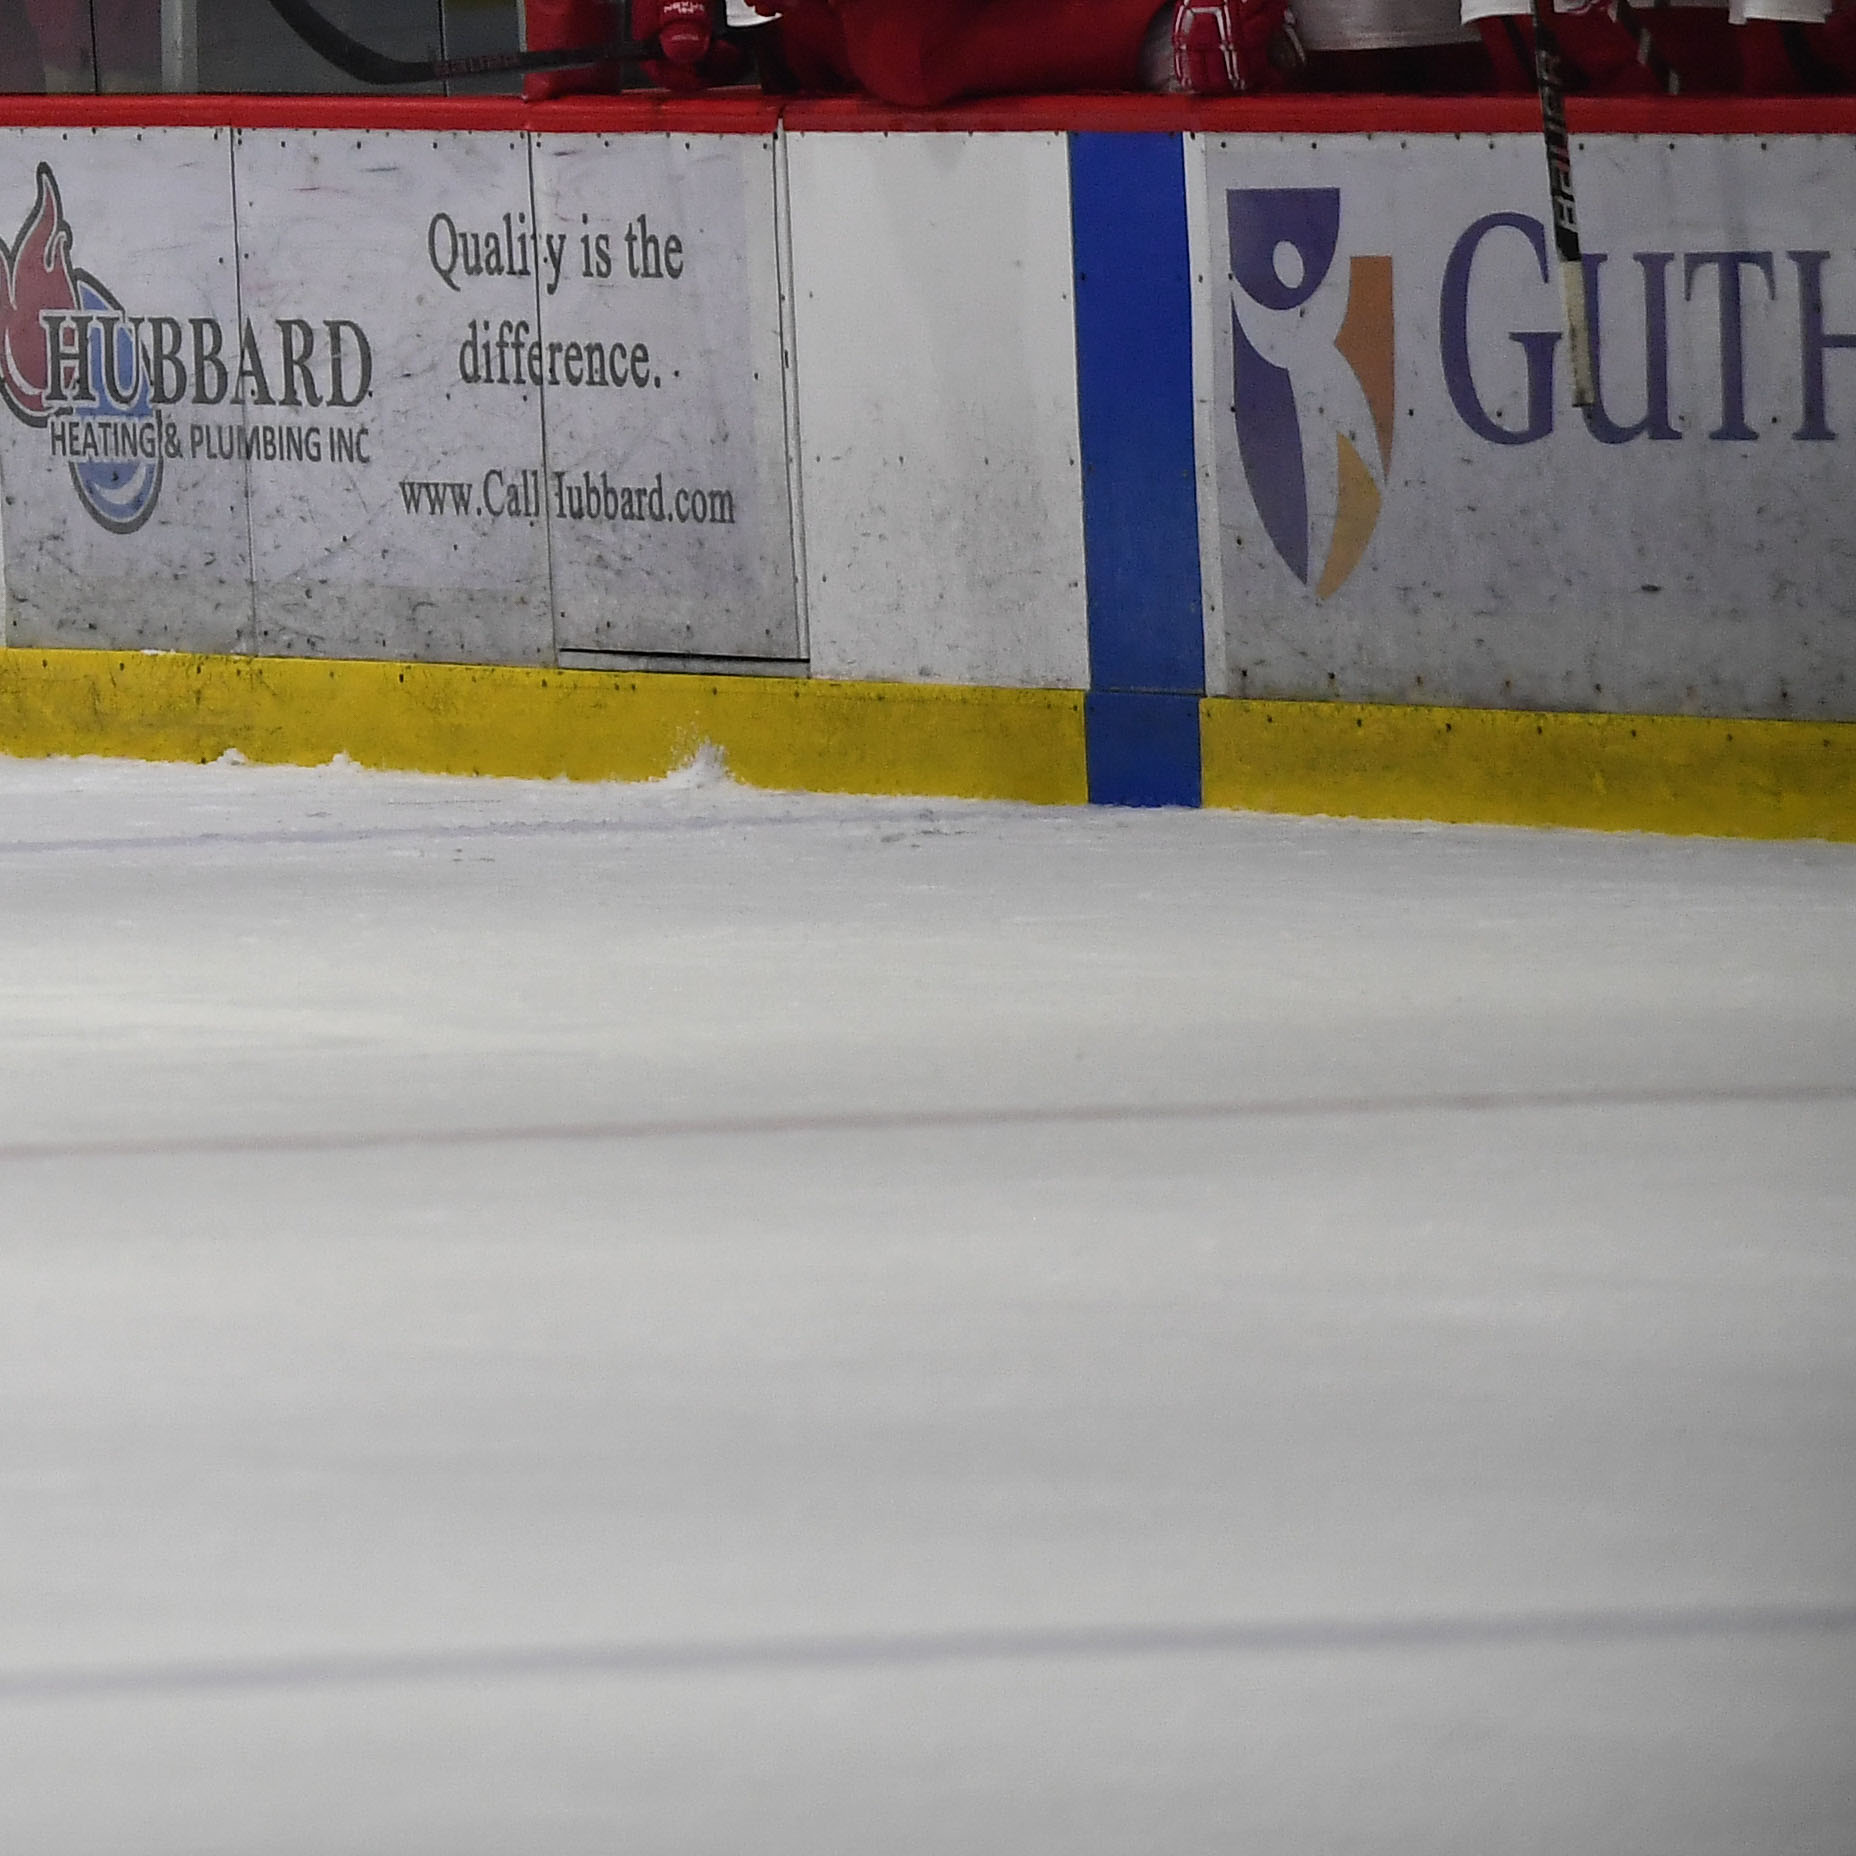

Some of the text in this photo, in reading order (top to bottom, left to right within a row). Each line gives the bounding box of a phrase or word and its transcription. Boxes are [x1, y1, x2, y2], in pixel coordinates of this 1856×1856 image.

[580, 212, 612, 279] is
[624, 213, 685, 280] the
[42, 315, 374, 409] HUBBARD
[458, 319, 662, 389] difference.
[50, 419, 372, 464] HEATING & PLUMBING INC
